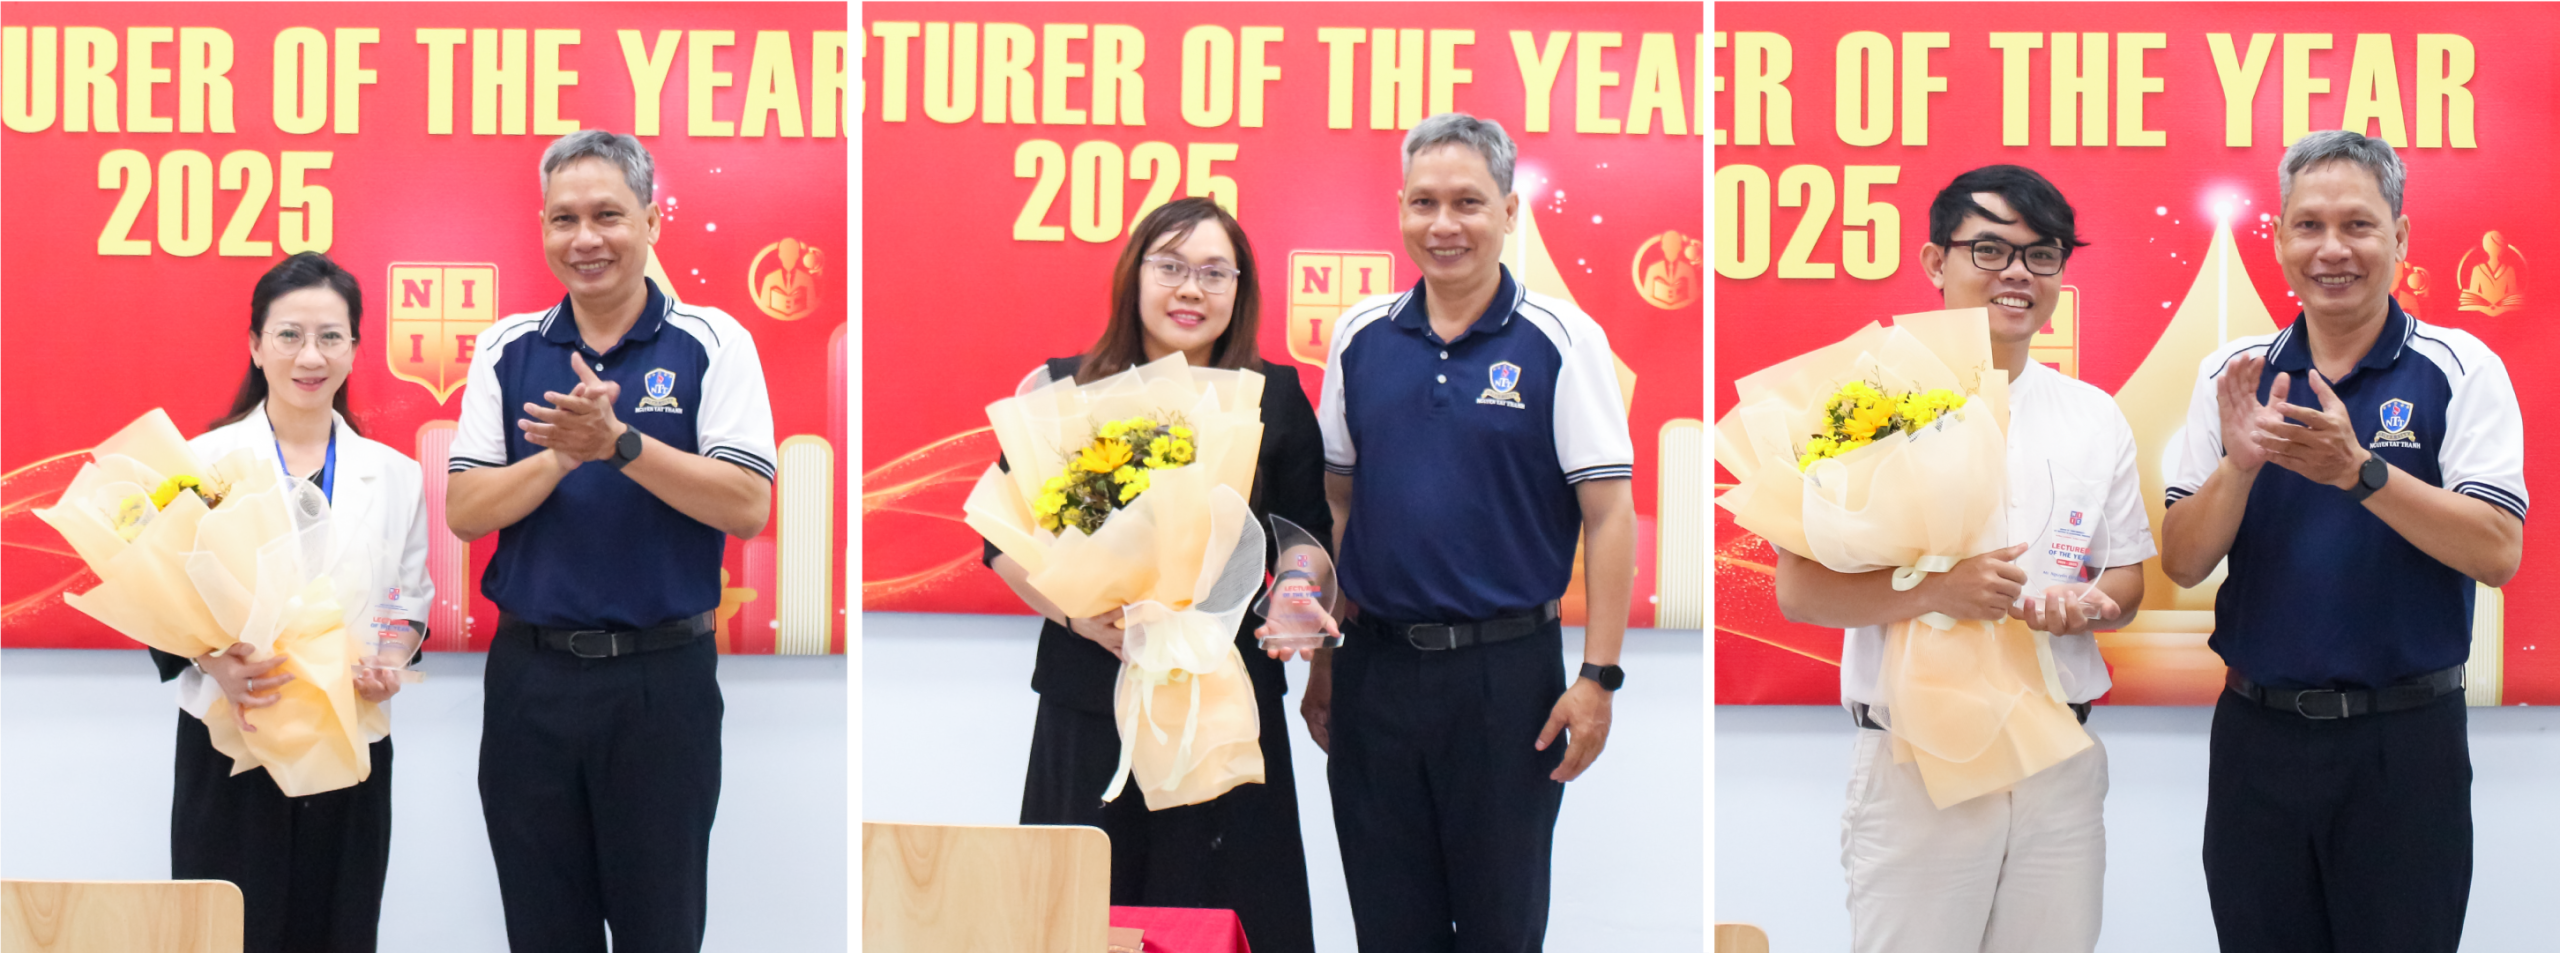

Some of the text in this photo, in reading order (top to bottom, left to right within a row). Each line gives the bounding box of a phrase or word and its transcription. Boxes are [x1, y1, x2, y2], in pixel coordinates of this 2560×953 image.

[2, 26, 236, 133] URER
[273, 27, 380, 134] OF
[416, 28, 581, 136] THE
[863, 21, 1703, 135] TURER OF THE YEA
[1836, 31, 1950, 147] OF
[1989, 32, 2167, 146] THE
[2206, 33, 2477, 148] YEAR
[98, 149, 333, 257] 2025
[1013, 138, 1239, 243] 2025
[2385, 416, 2405, 427] NTT
[2060, 551, 2072, 559] THE
